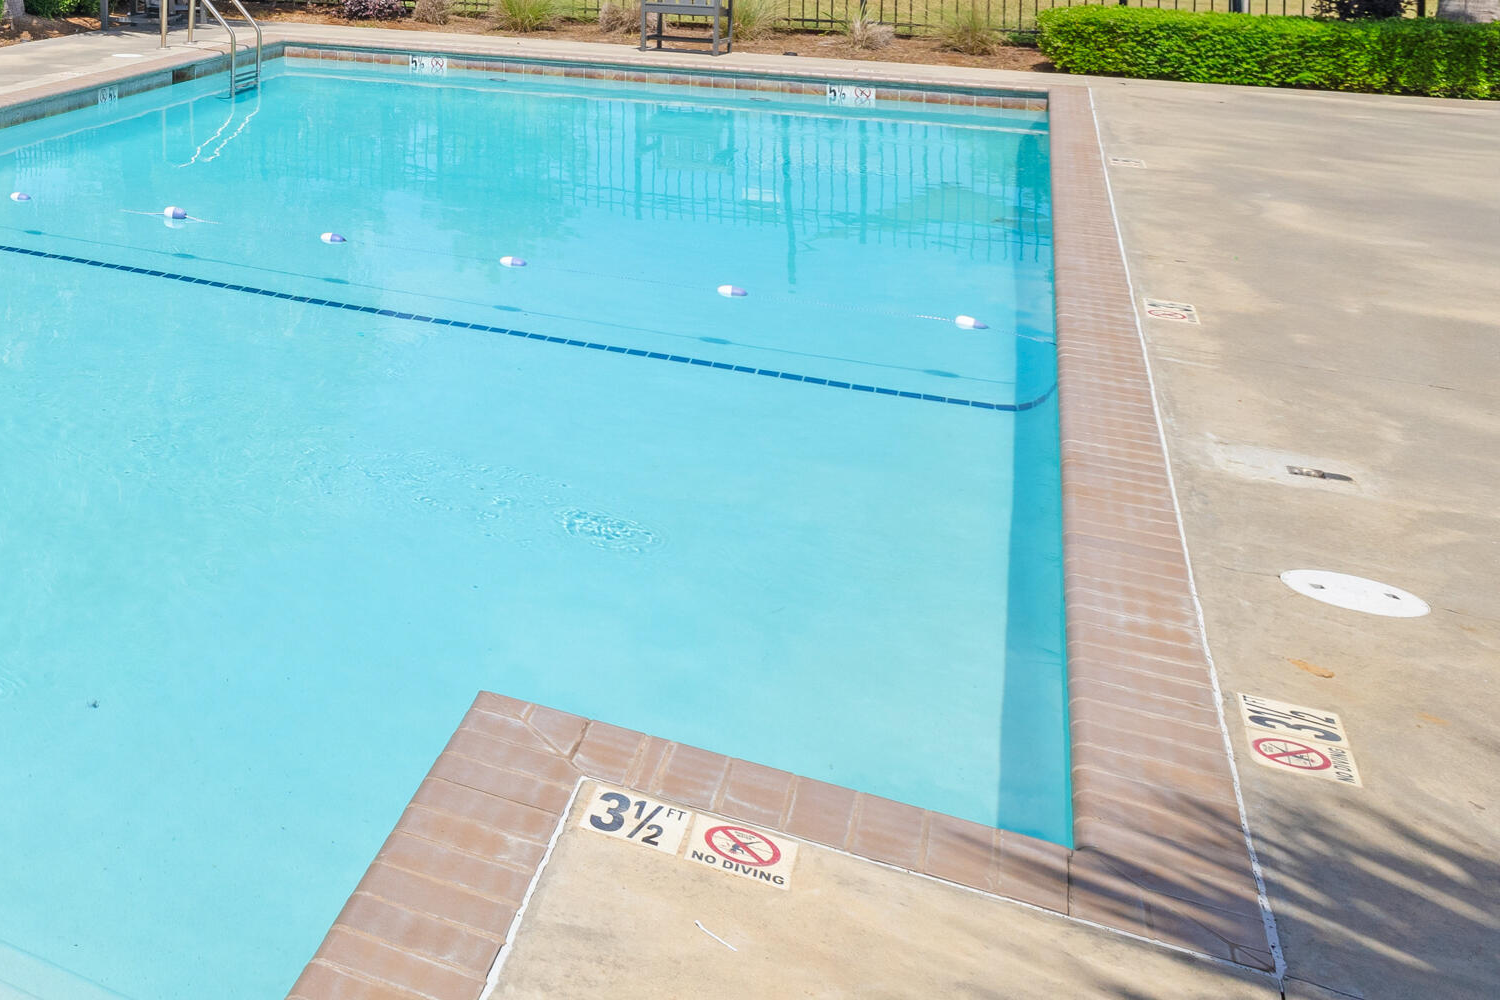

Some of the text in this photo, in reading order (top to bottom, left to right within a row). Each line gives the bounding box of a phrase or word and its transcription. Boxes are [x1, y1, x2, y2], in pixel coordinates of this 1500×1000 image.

[1328, 747, 1352, 772] DIVING
[666, 808, 687, 821] FT
[691, 850, 785, 885] NO DIVING
